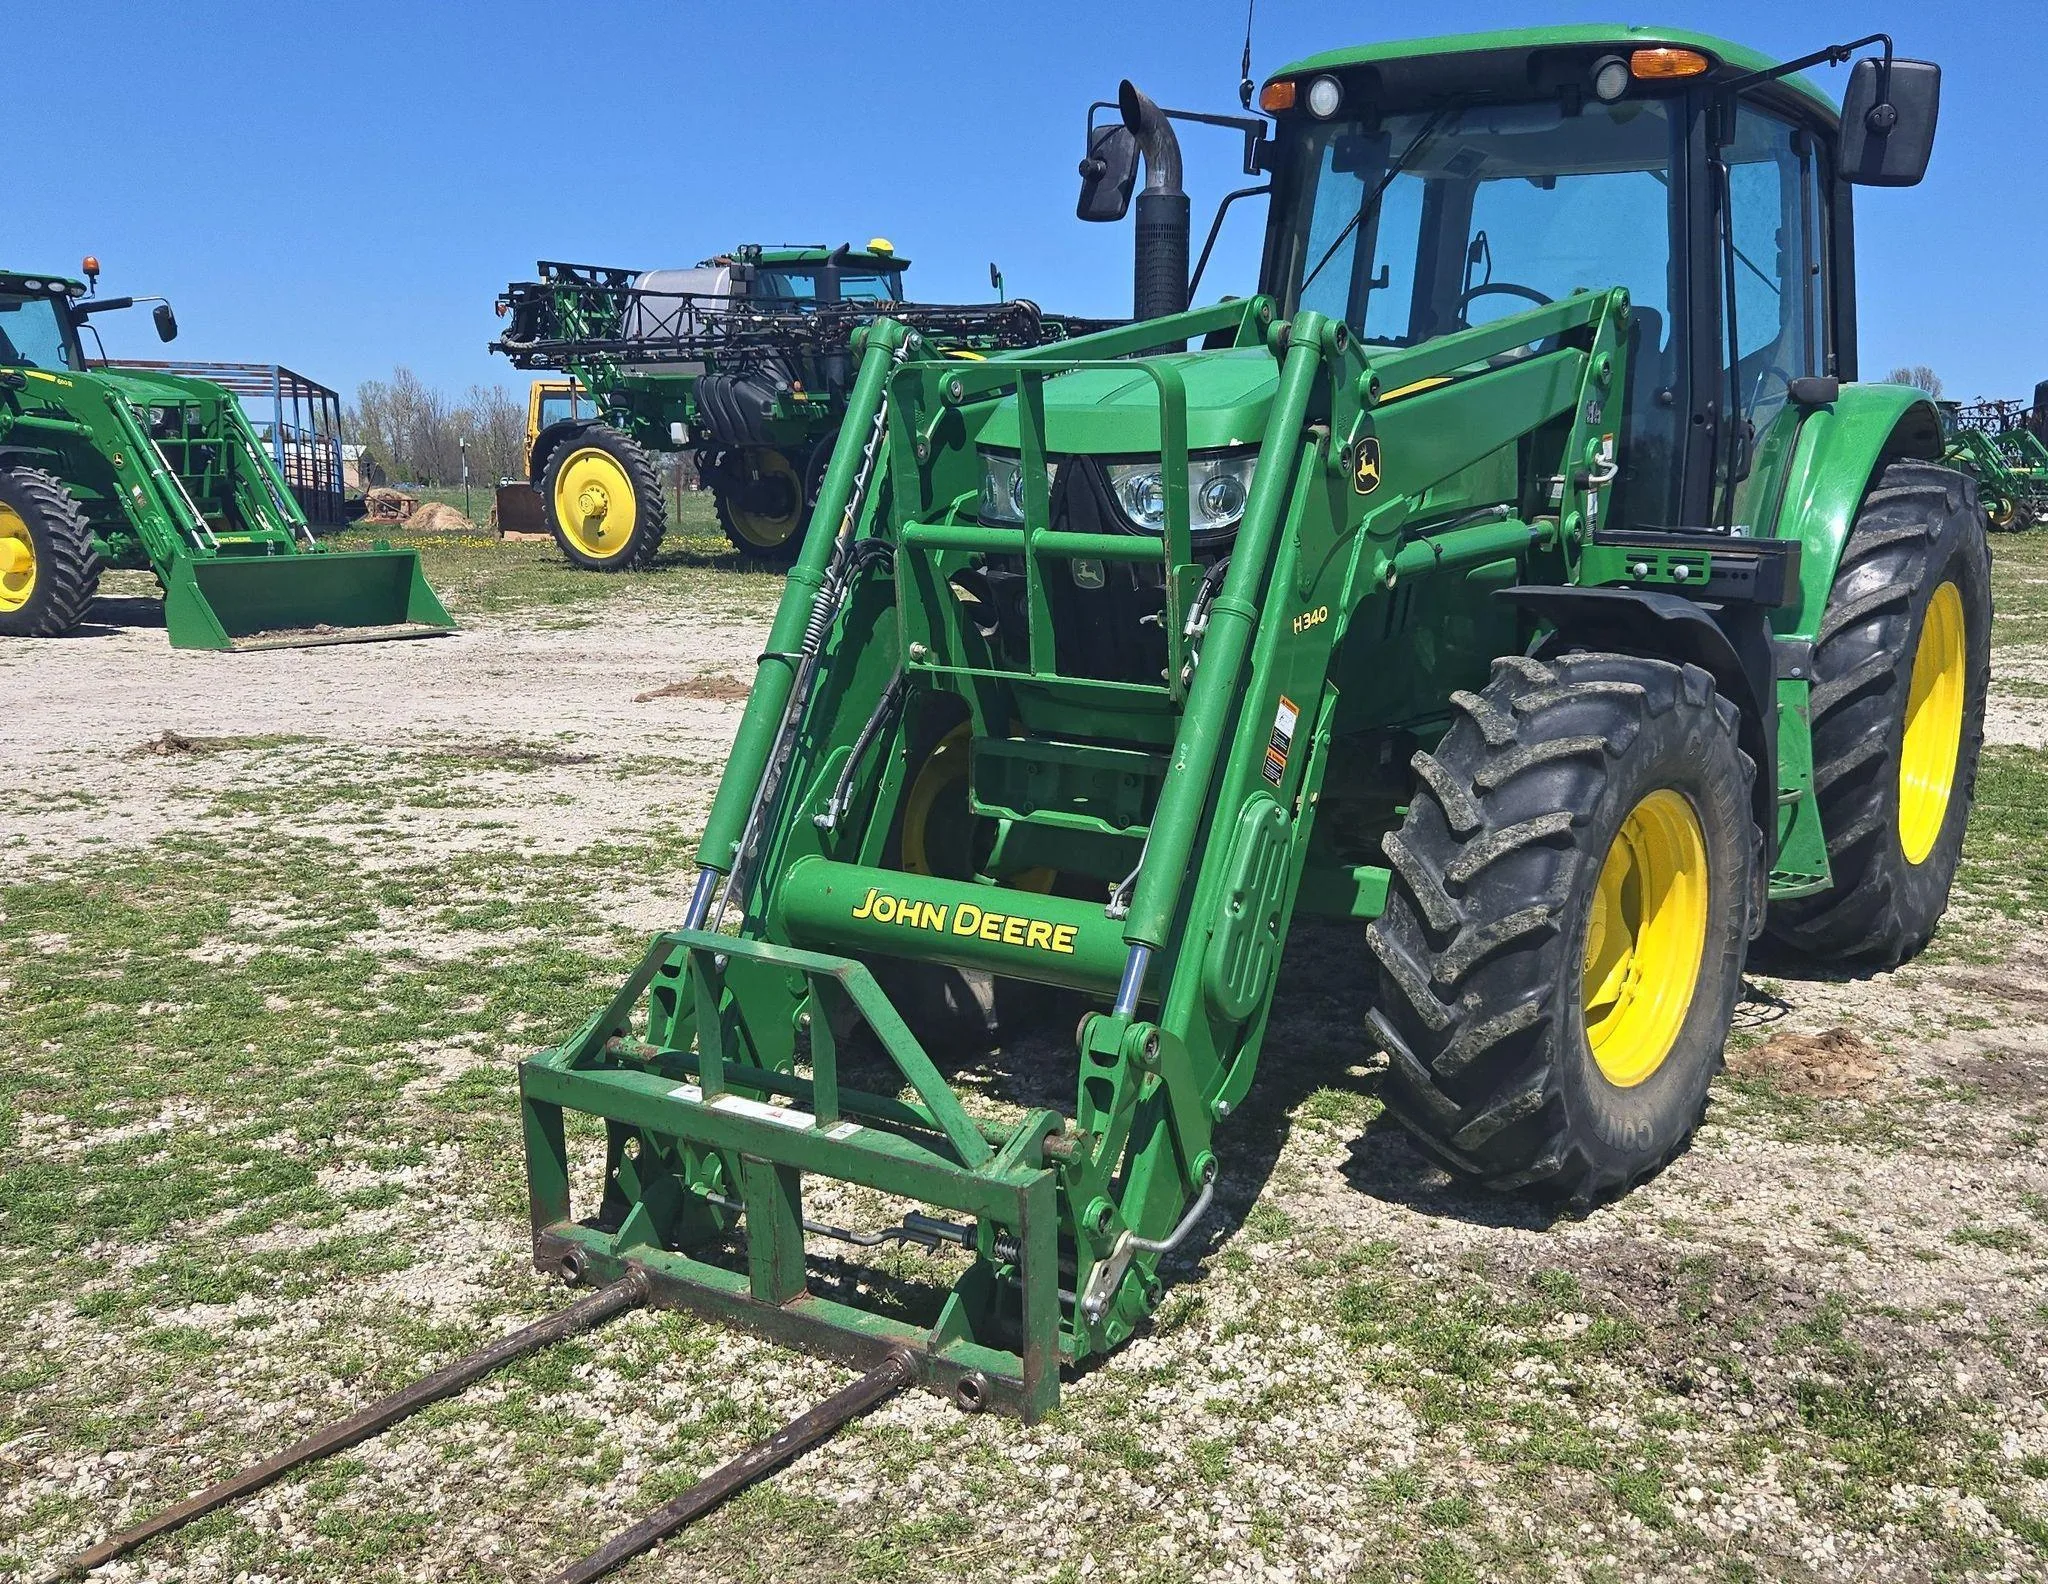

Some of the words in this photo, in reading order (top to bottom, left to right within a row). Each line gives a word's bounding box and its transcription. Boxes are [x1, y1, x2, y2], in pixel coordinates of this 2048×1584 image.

[1293, 605, 1328, 635] H340
[852, 888, 949, 932] JOHN
[952, 903, 1079, 954] DEERE
